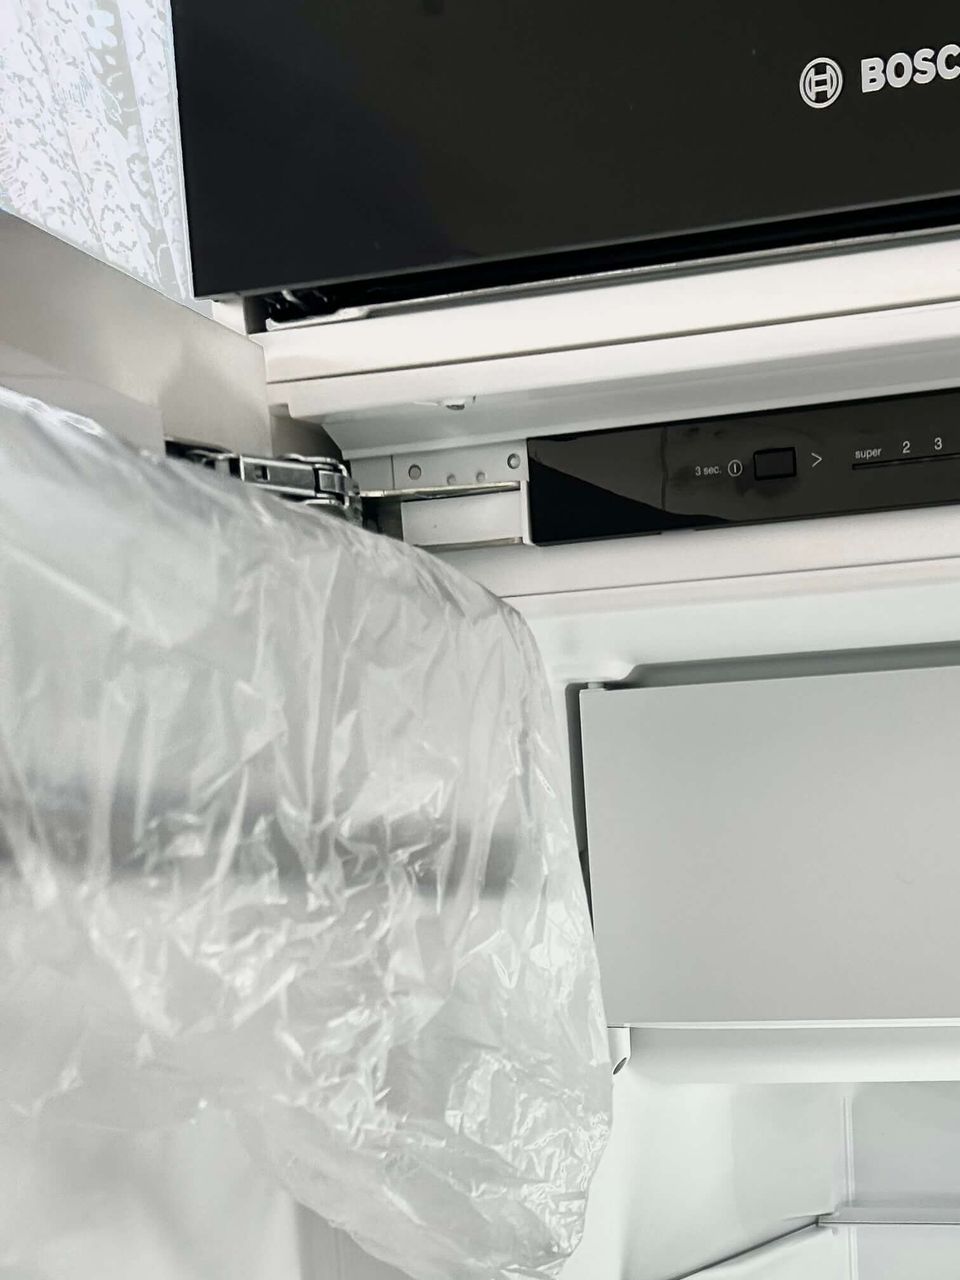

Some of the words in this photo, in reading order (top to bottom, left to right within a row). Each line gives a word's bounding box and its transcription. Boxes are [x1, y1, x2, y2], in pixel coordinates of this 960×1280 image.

[855, 447, 882, 460] super
[902, 441, 911, 454] 2
[934, 437, 943, 450] 3
[695, 466, 701, 477] 3
[703, 464, 722, 476] sec.
